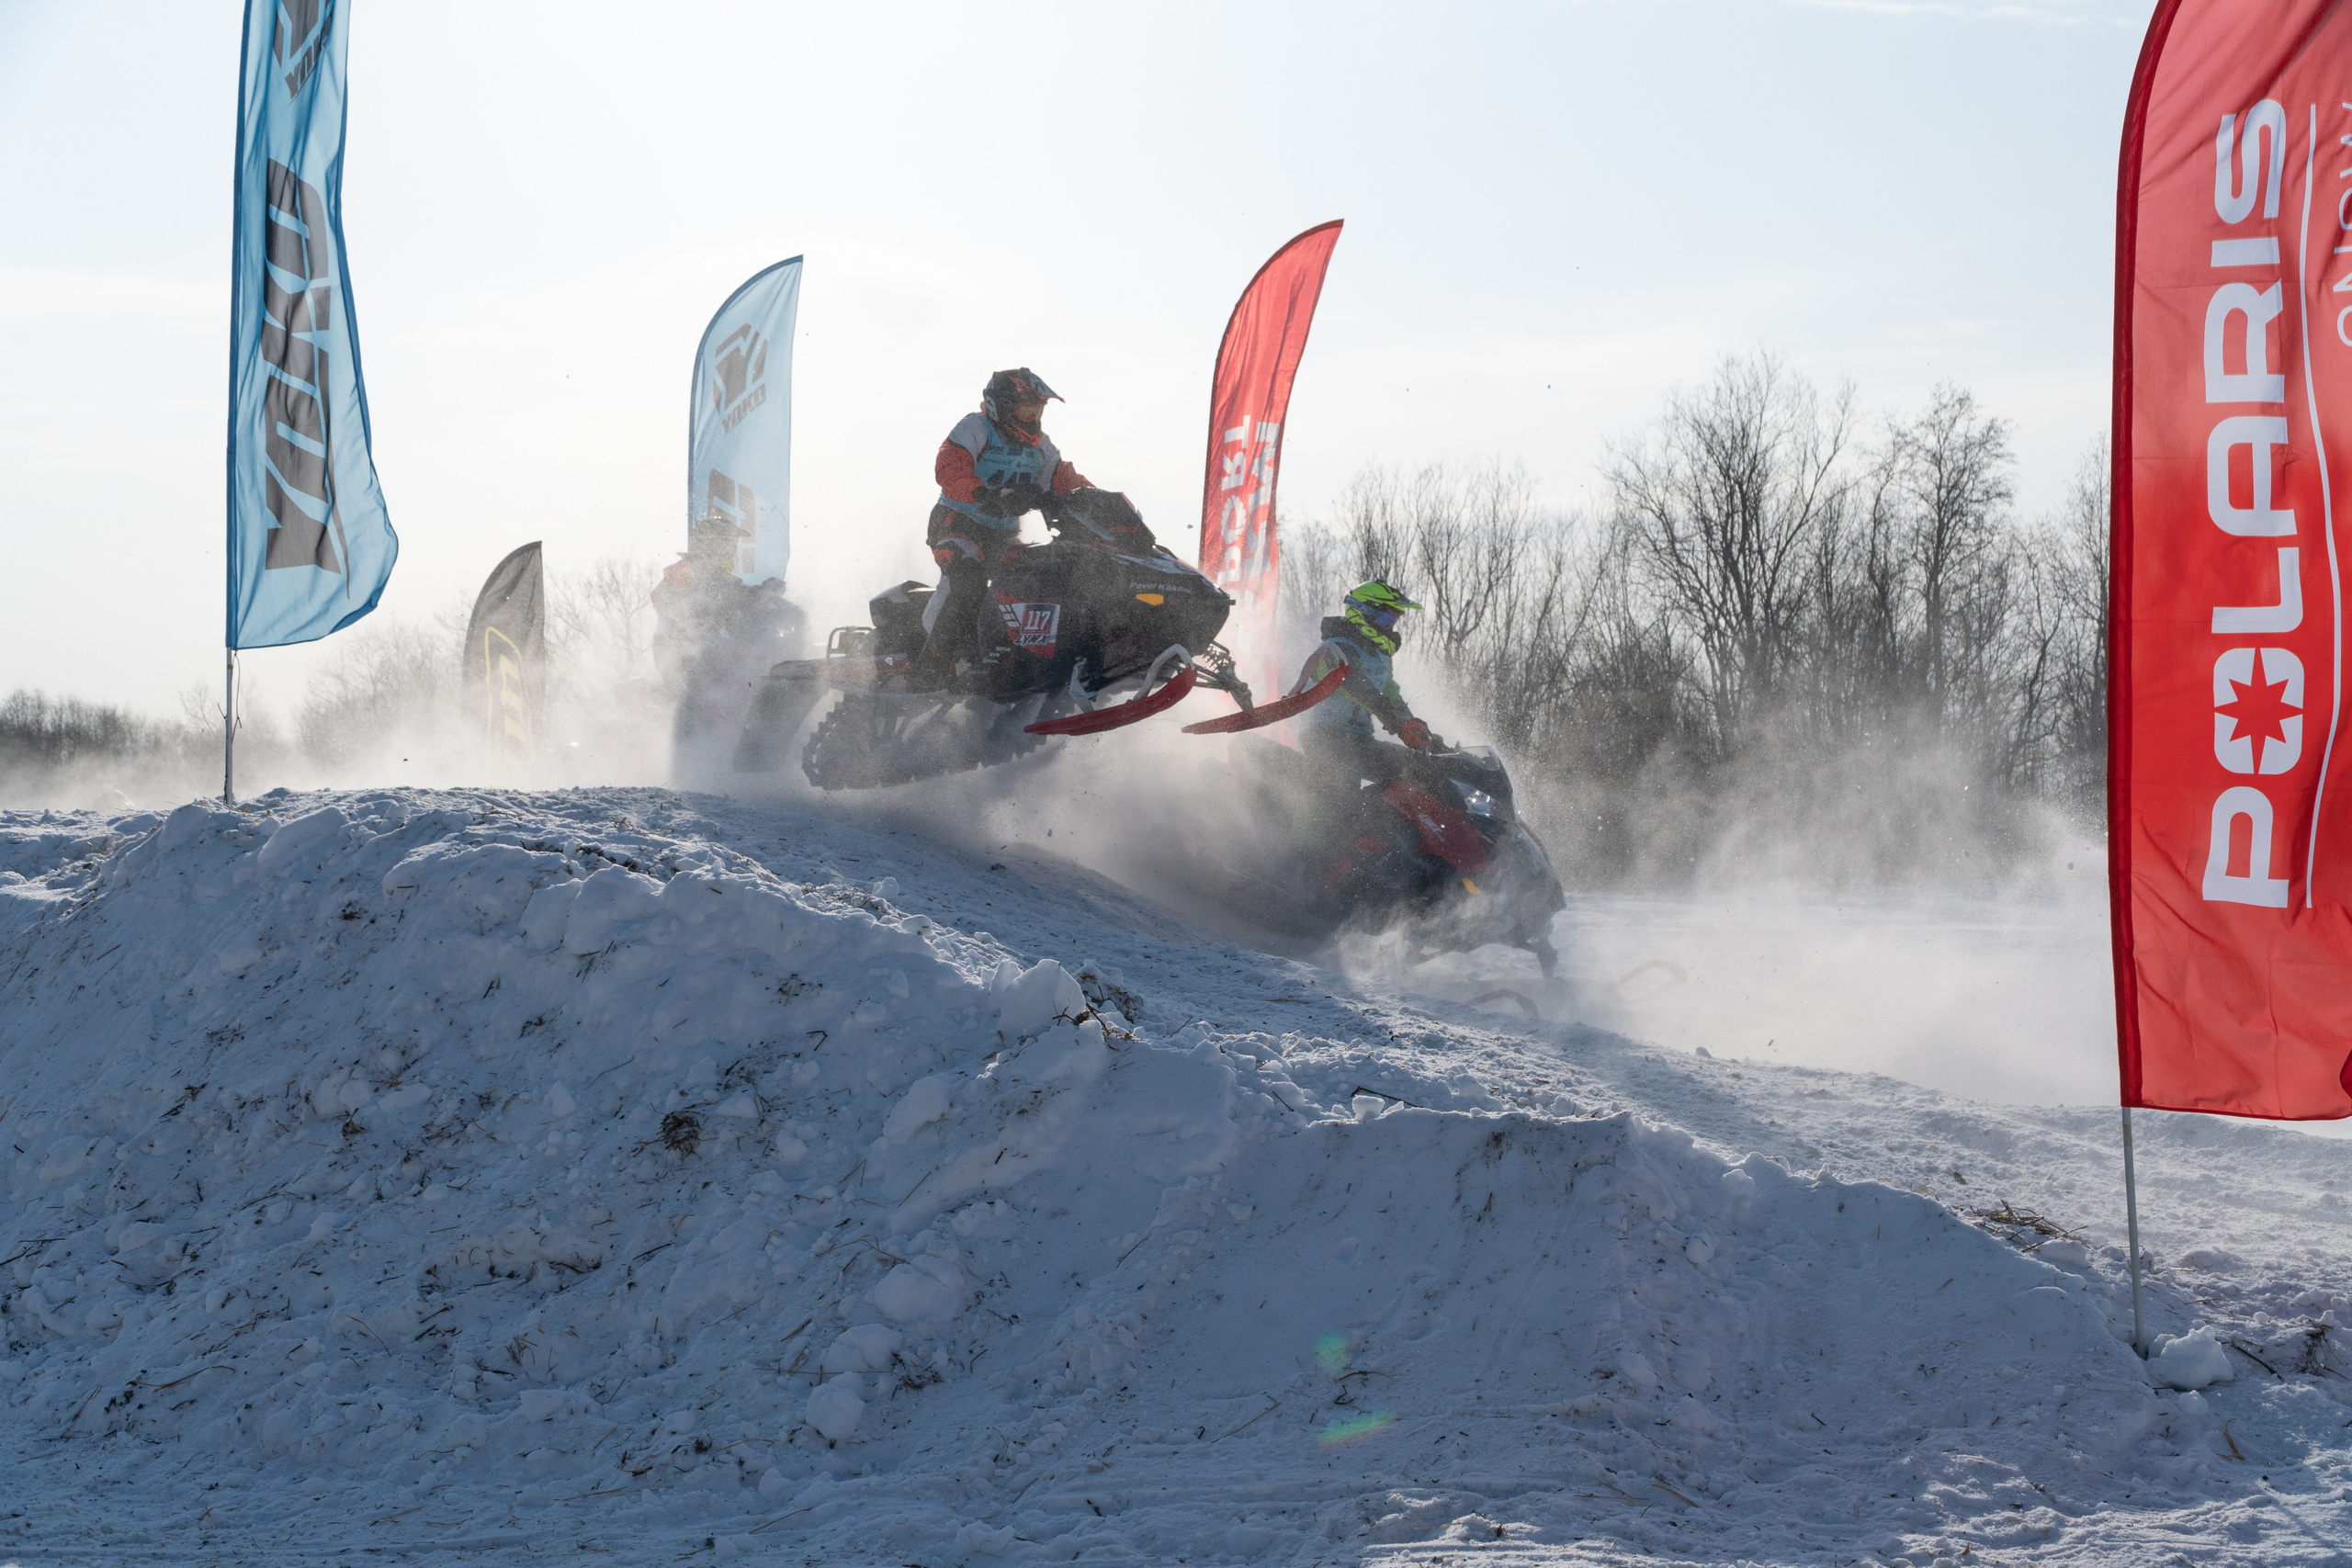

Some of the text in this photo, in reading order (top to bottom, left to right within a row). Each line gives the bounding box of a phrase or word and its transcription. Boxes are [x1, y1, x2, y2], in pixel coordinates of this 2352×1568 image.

[260, 157, 342, 575] YOKO
[722, 383, 766, 435] YOKO
[1024, 611, 1051, 630] 117
[2203, 98, 2304, 908] POLARIS
